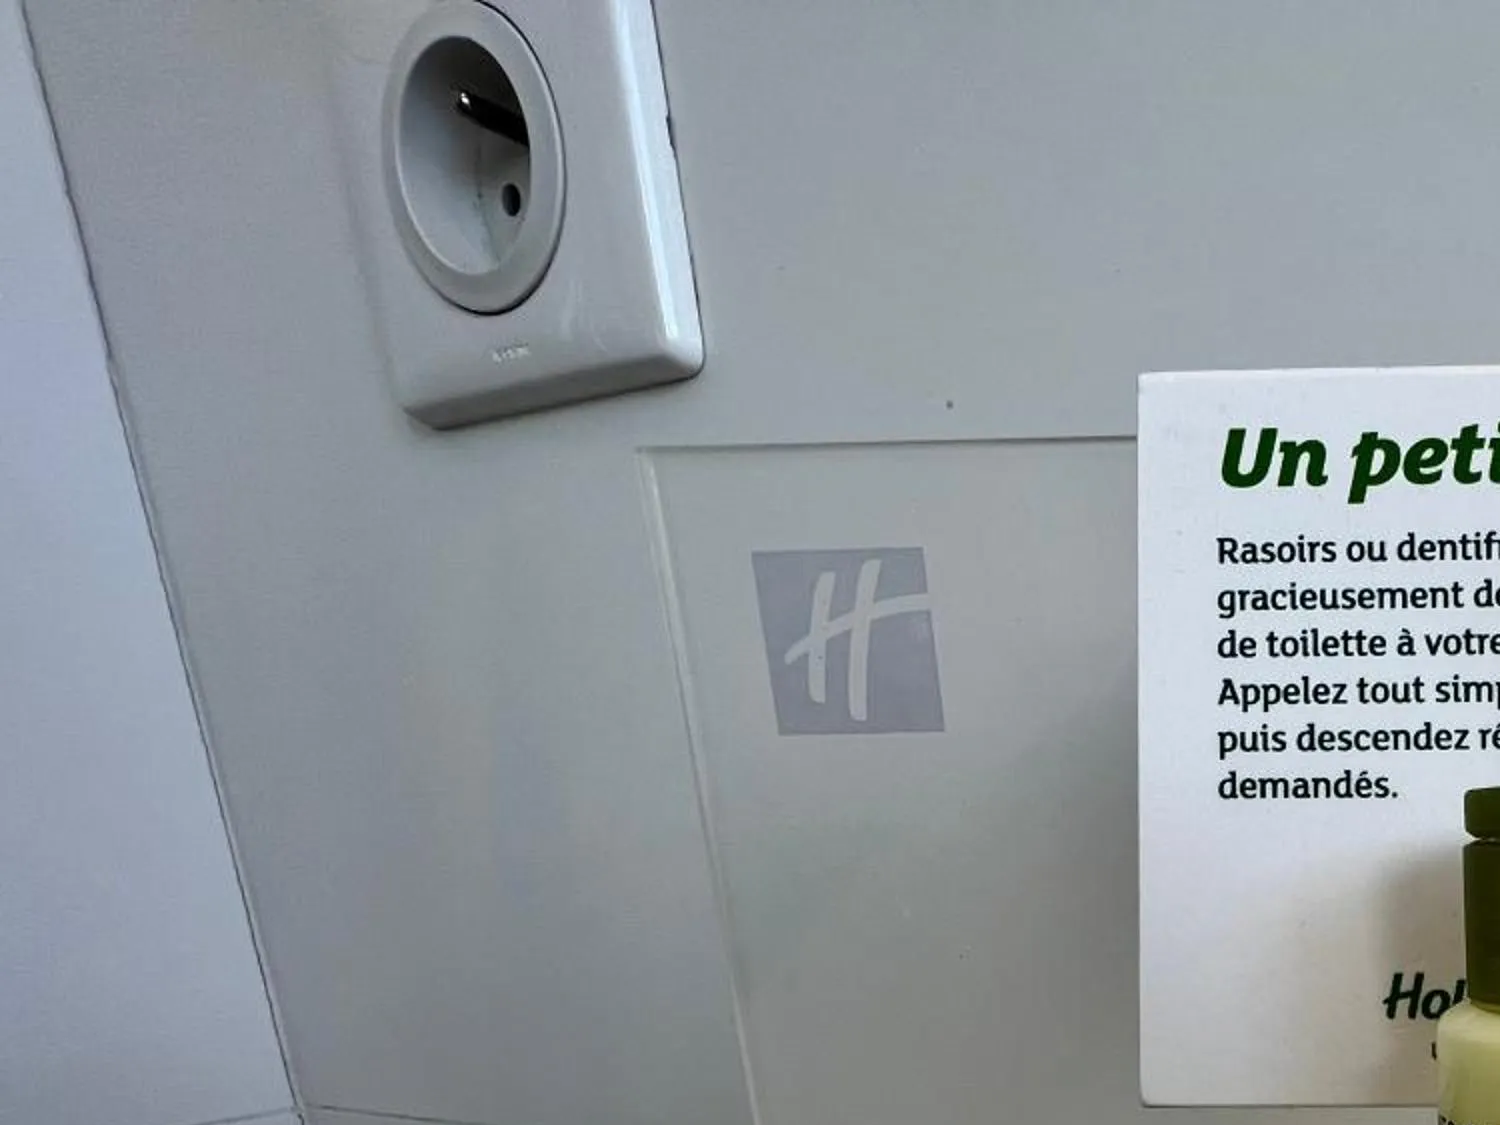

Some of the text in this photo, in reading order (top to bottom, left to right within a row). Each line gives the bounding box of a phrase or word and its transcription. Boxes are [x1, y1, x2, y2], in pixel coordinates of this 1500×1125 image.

[1221, 427, 1329, 489] Un
[1216, 534, 1337, 565] Rasoirs
[1346, 540, 1388, 563] ou
[1217, 581, 1465, 619] gracieusement
[1217, 629, 1257, 659] de
[1265, 627, 1387, 658] toilette
[1396, 627, 1417, 657] à
[1217, 675, 1348, 713] Appelez
[1356, 676, 1426, 705] tout
[1217, 723, 1287, 761] puis
[1296, 721, 1470, 752] descendez
[1217, 769, 1398, 800] demandés.
[1382, 971, 1466, 1020] Hol
